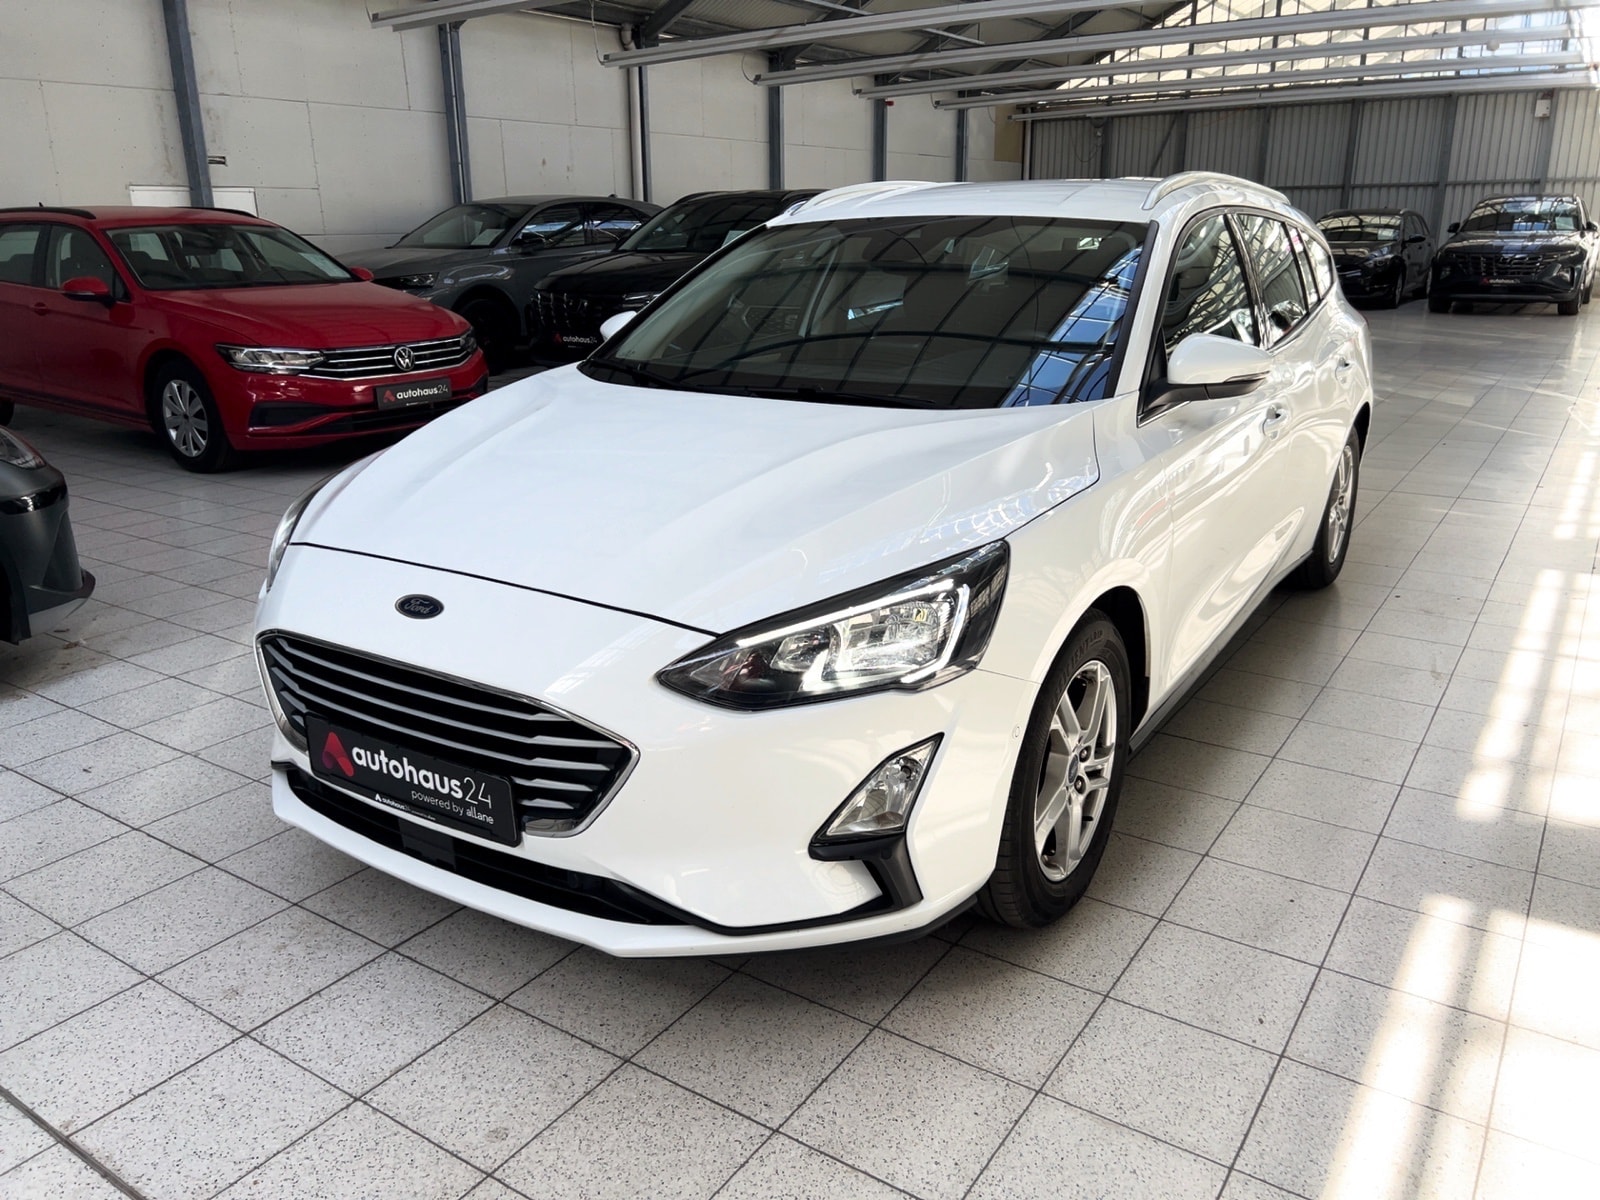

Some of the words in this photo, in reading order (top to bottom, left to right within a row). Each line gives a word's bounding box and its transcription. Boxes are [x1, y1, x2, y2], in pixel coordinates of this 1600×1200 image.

[562, 335, 598, 344] autohaus24
[396, 384, 449, 399] autohaus24
[351, 746, 492, 809] autohaus24
[411, 790, 451, 810] powered
[452, 802, 464, 816] by
